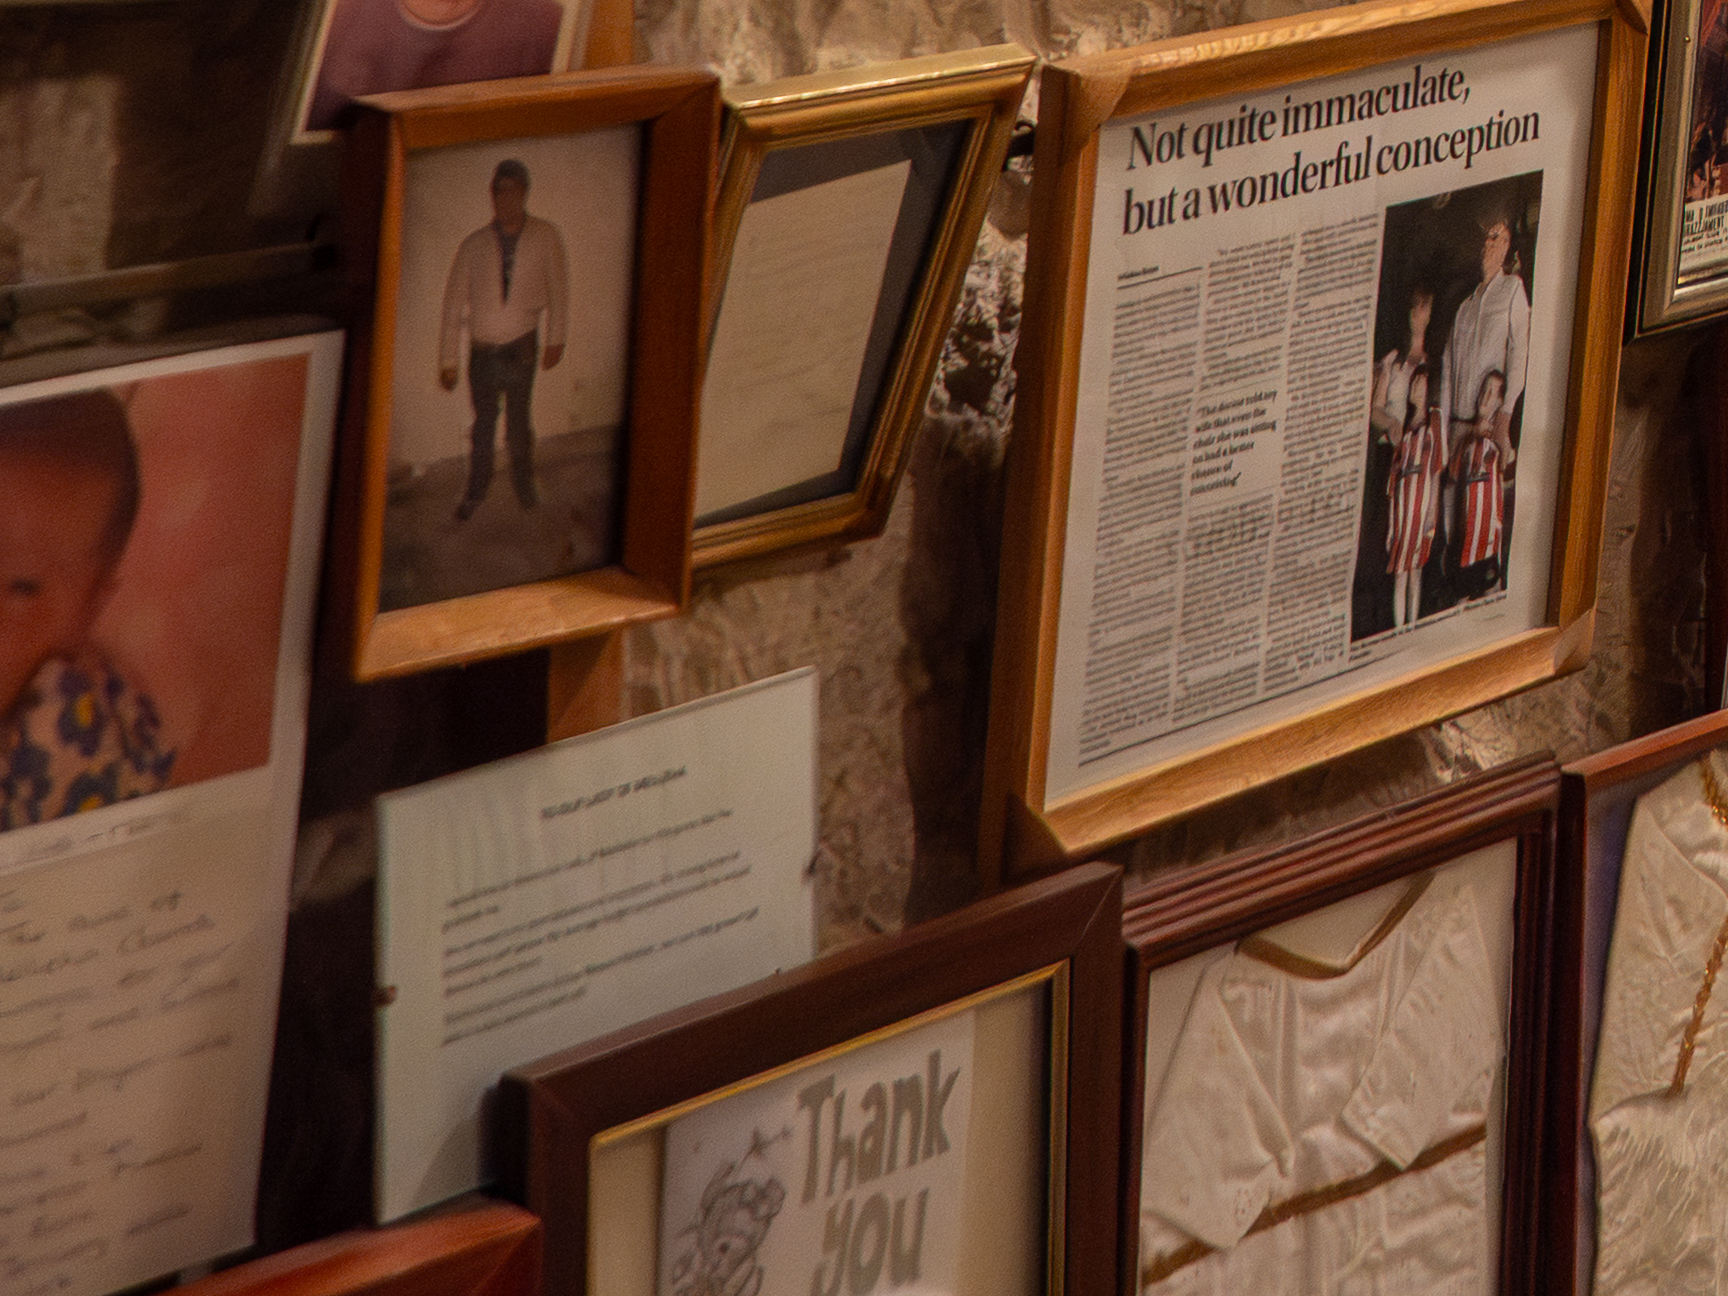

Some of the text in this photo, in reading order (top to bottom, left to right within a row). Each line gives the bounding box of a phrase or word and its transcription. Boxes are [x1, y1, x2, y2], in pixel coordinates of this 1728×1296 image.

[1121, 108, 1541, 237] but a wonderful conception
[1125, 63, 1472, 172] Not quite immaculate,
[796, 1048, 962, 1206] Thank
